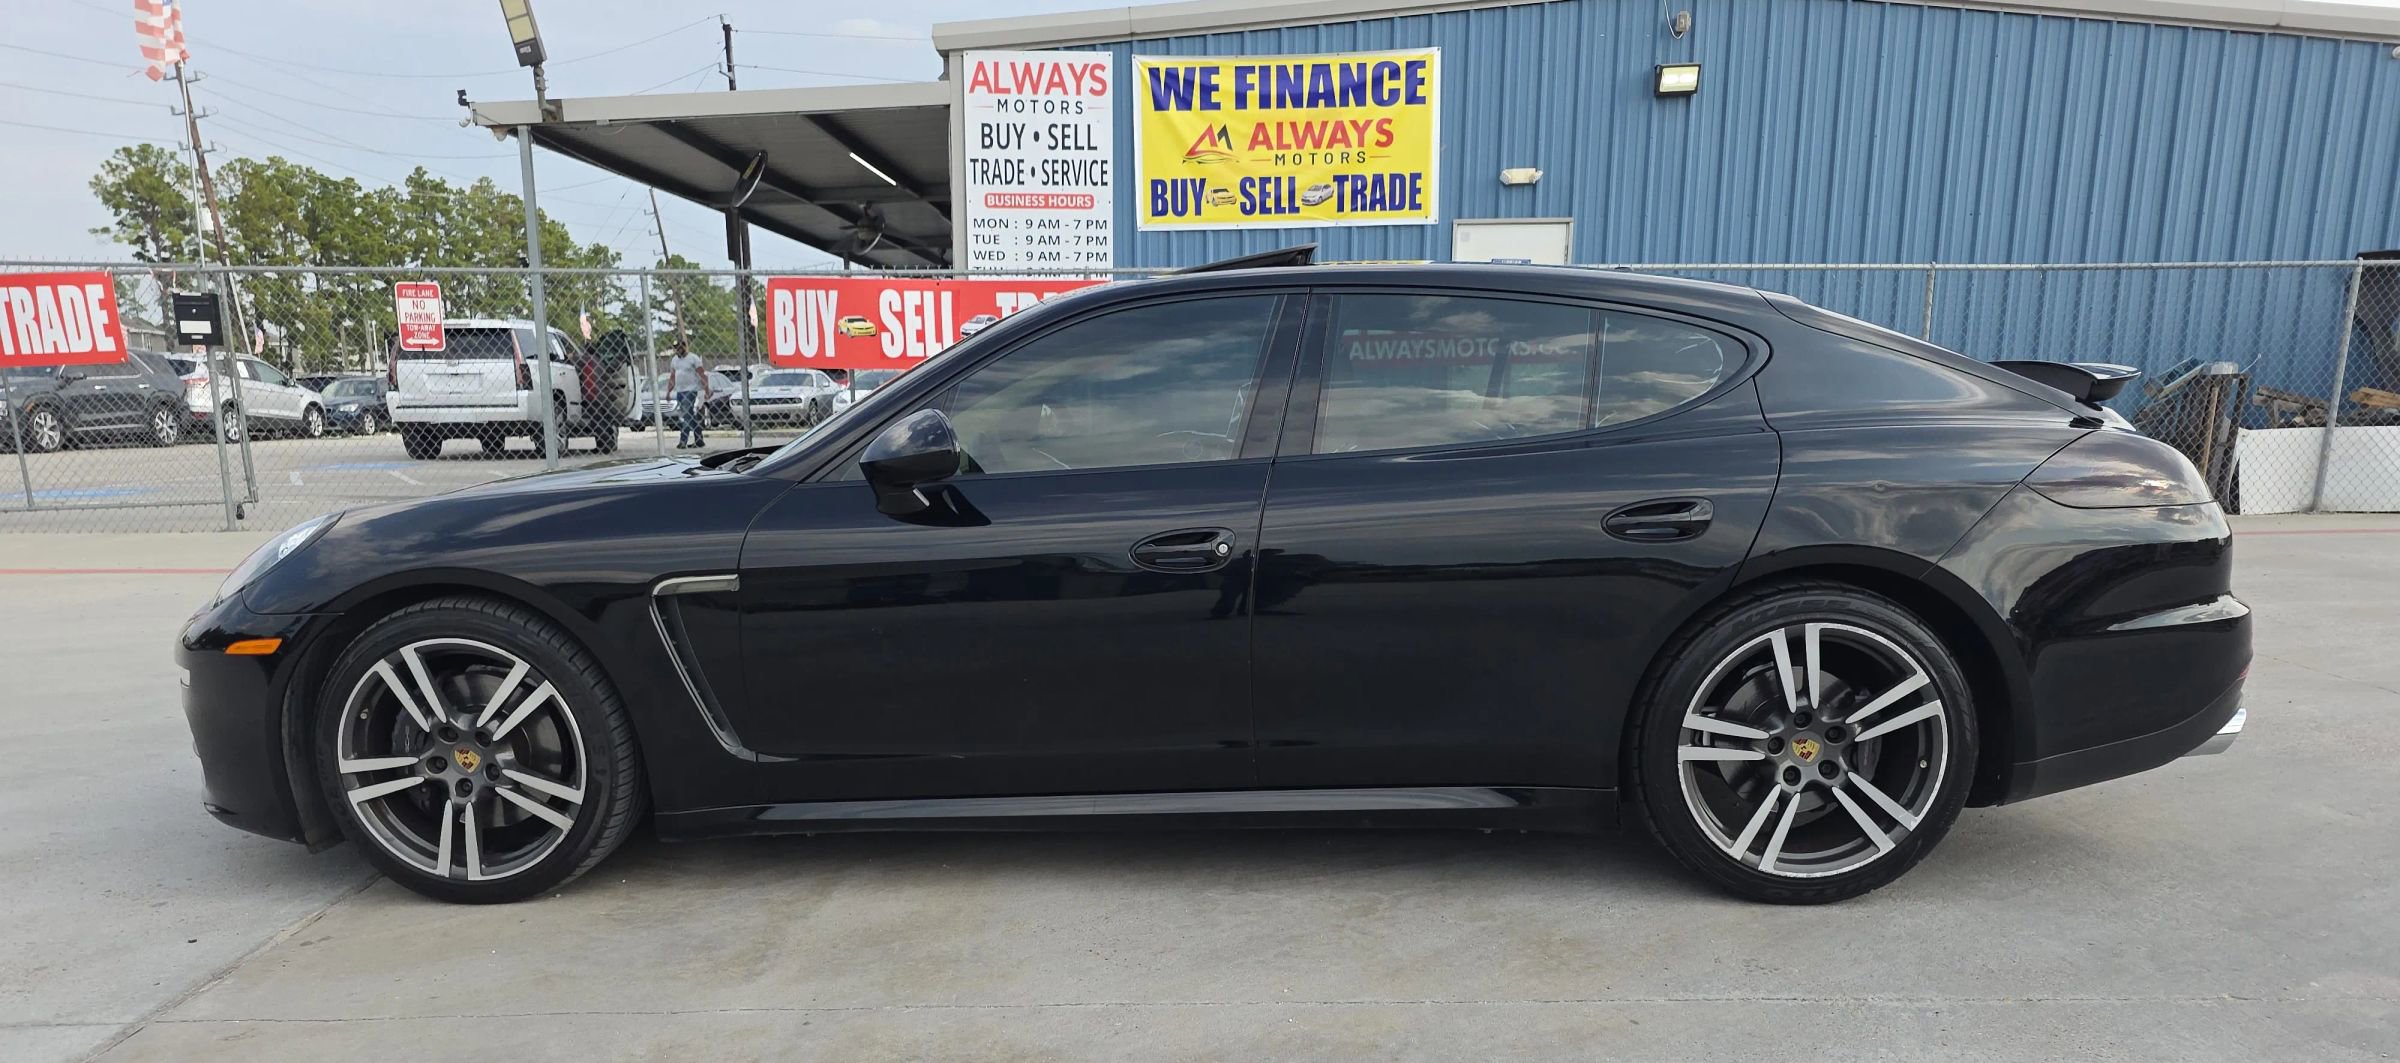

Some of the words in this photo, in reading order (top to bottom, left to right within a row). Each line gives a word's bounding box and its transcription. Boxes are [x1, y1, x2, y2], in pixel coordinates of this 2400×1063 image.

[969, 61, 1108, 97] ALWAYS
[1148, 65, 1222, 112] WE
[1234, 59, 1427, 111] FINANCE
[997, 99, 1084, 115] MOTORS
[981, 123, 1026, 150] BUY
[1048, 123, 1097, 151] SELL
[1247, 118, 1394, 152] ALWAYS
[1275, 151, 1366, 166] MOTORS
[970, 158, 1025, 186] TRADE
[1041, 159, 1108, 187] SERVICE
[987, 194, 1045, 207] BUSINESS
[1048, 195, 1092, 208] HOURS
[1150, 177, 1207, 217] BUY
[1239, 175, 1301, 216] SELL
[1333, 172, 1423, 214] TRADE
[973, 218, 1009, 229] MON
[1025, 218, 1033, 230] 9
[1037, 219, 1060, 230] AM
[1073, 219, 1081, 230] 7
[1086, 219, 1107, 230] PM
[973, 234, 1000, 245] TUE
[1025, 235, 1033, 246] 9
[1037, 235, 1060, 246] AM
[1073, 235, 1081, 246] 7
[1086, 235, 1107, 246] PM
[973, 250, 1006, 261] WED
[1025, 251, 1034, 262] 9
[1037, 251, 1060, 262] AM
[1073, 251, 1081, 262] 7
[1086, 252, 1107, 262] PM
[402, 288, 416, 297] FIRE
[418, 289, 434, 298] LANE
[412, 300, 426, 310] NO
[0, 284, 117, 355] TRADE
[405, 312, 436, 323] PARKING
[773, 288, 838, 358] BUY
[406, 324, 436, 332] TOW-AWAY
[414, 331, 430, 339] ZONE
